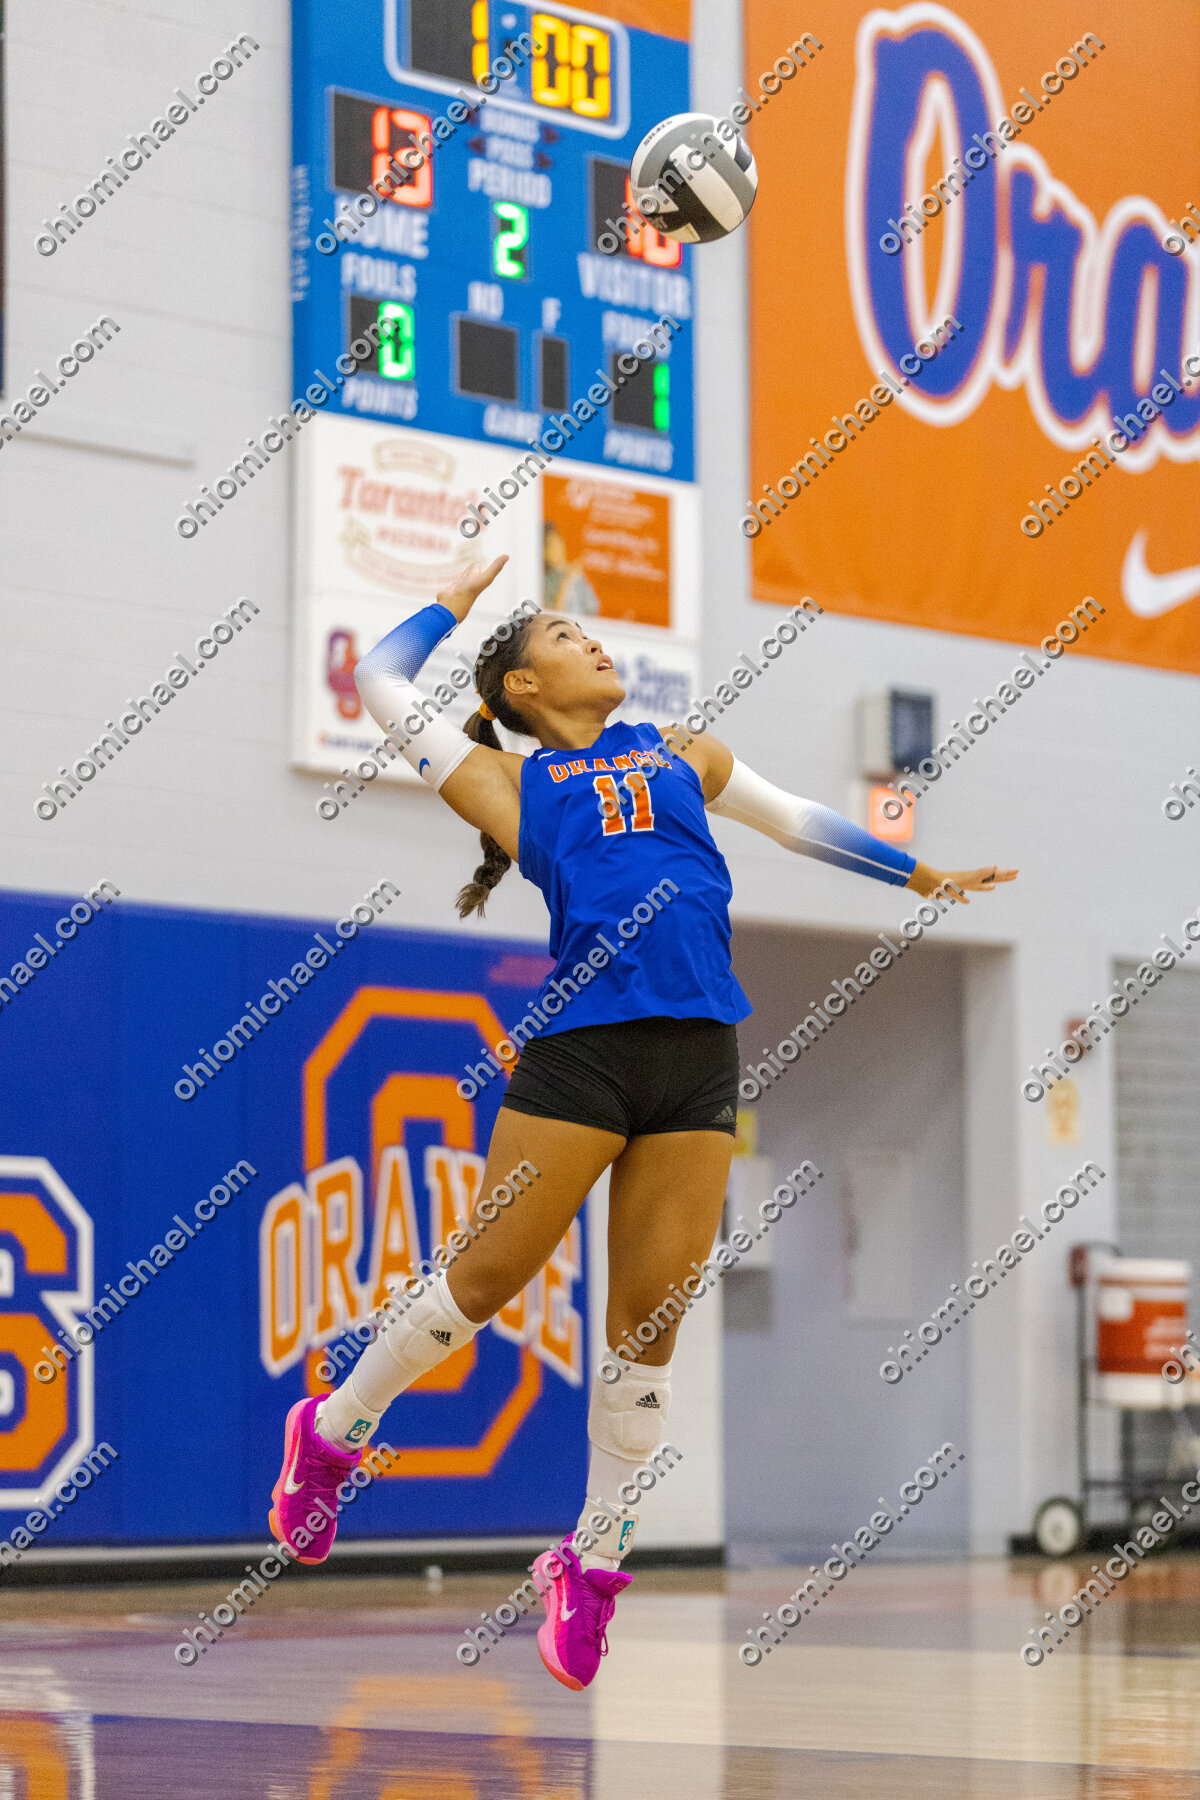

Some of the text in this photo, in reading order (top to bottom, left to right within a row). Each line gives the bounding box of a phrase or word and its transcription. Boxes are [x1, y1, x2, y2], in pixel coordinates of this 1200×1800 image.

[494, 201, 529, 278] 2
[378, 301, 415, 380] 0
[653, 361, 670, 432] 1
[593, 771, 655, 837] 11
[259, 1145, 583, 1388] ORANE
